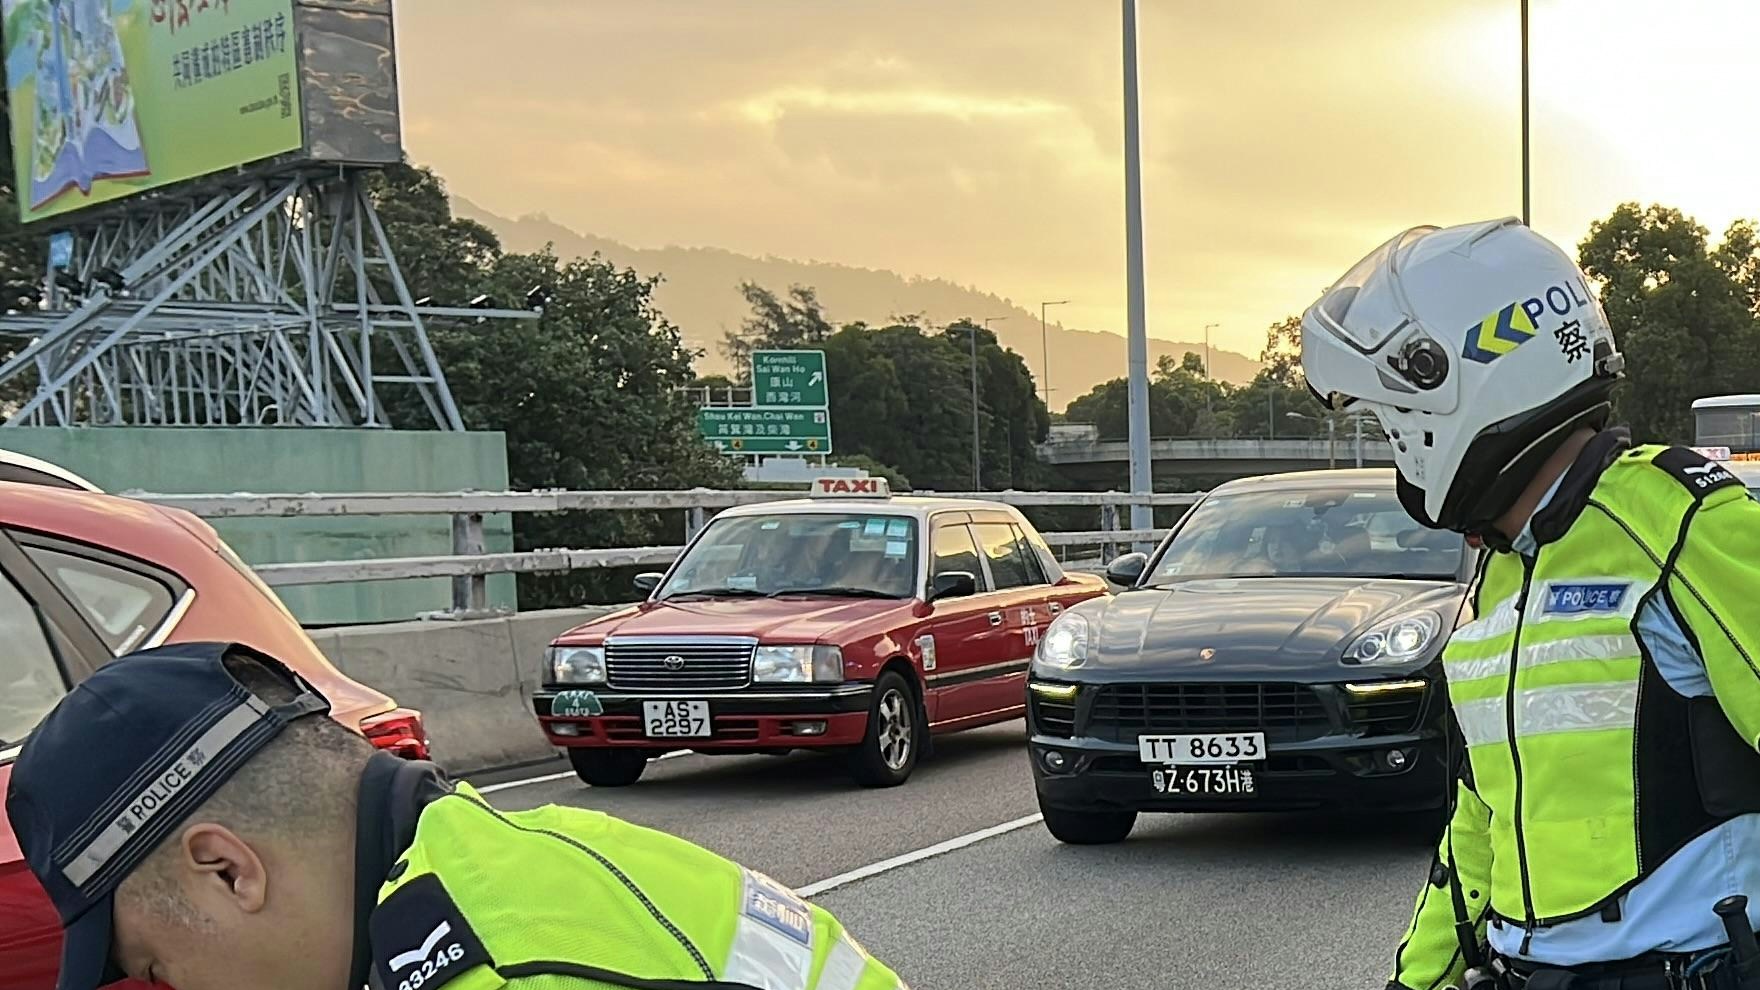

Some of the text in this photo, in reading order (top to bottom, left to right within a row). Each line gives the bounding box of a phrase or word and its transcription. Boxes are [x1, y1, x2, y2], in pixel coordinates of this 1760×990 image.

[1553, 319, 1591, 364] 察
[756, 365, 806, 373] Sai Wan Ho
[762, 356, 797, 364] Kornhill
[818, 479, 878, 493] TAXI
[665, 701, 690, 719] AS
[650, 718, 705, 736] 2297
[1145, 736, 1258, 759] TT 8633
[130, 762, 192, 821] POLICE
